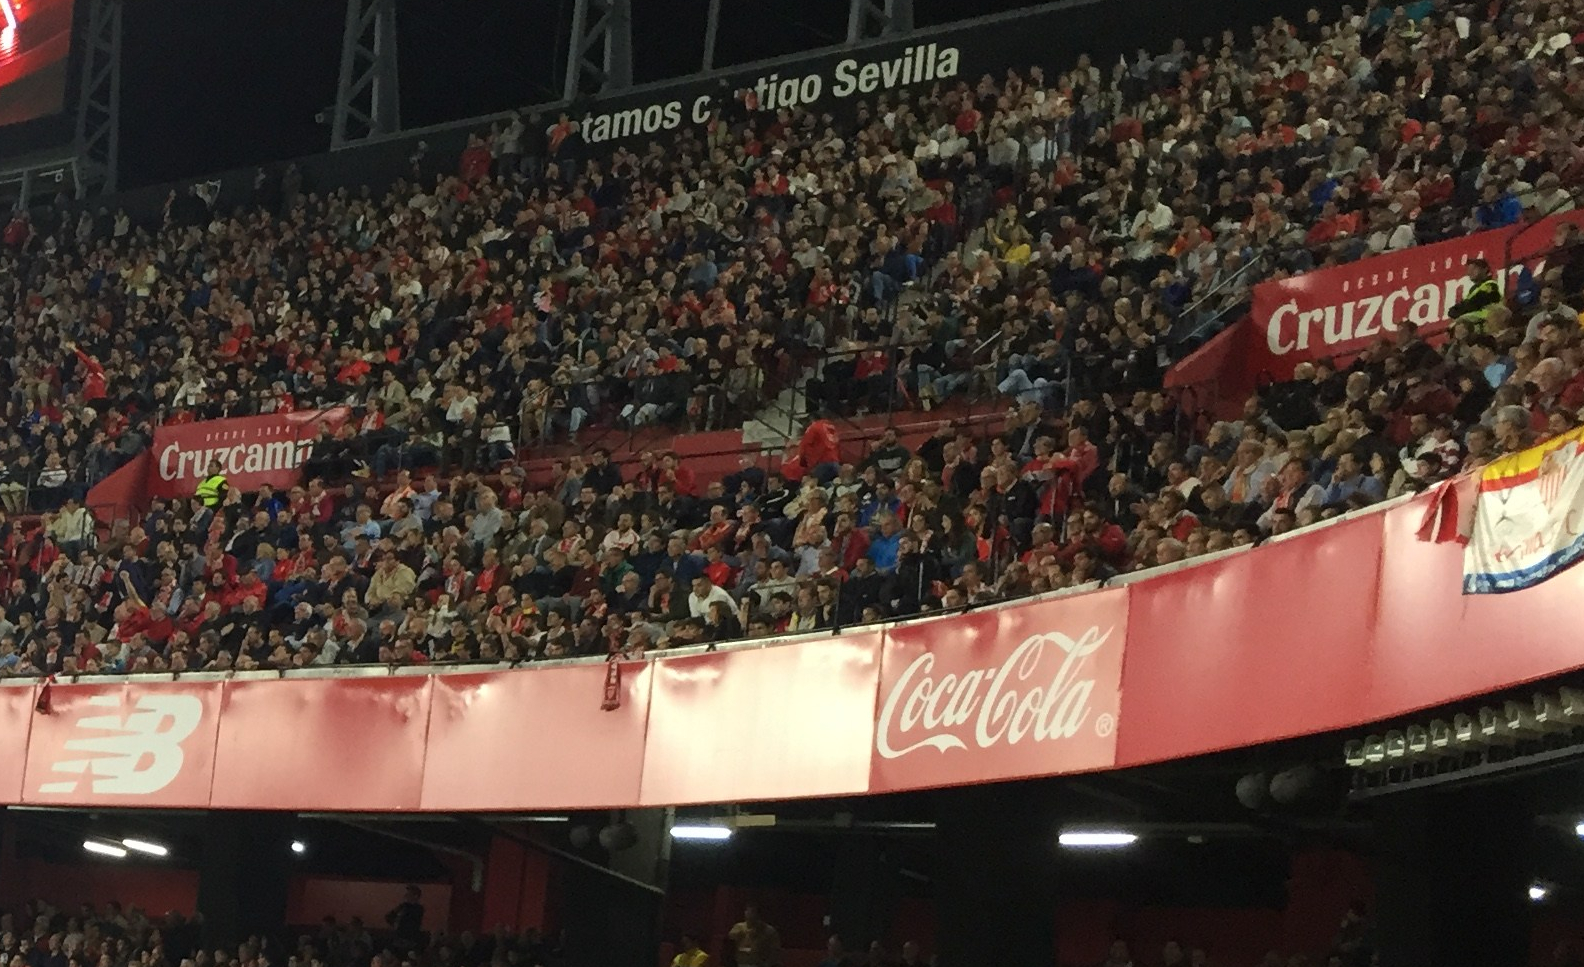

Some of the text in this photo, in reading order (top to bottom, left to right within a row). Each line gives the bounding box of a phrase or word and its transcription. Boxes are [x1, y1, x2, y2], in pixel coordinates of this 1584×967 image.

[581, 43, 959, 144] tamos ctigo Sevilla
[160, 438, 314, 482] Cruzcamp
